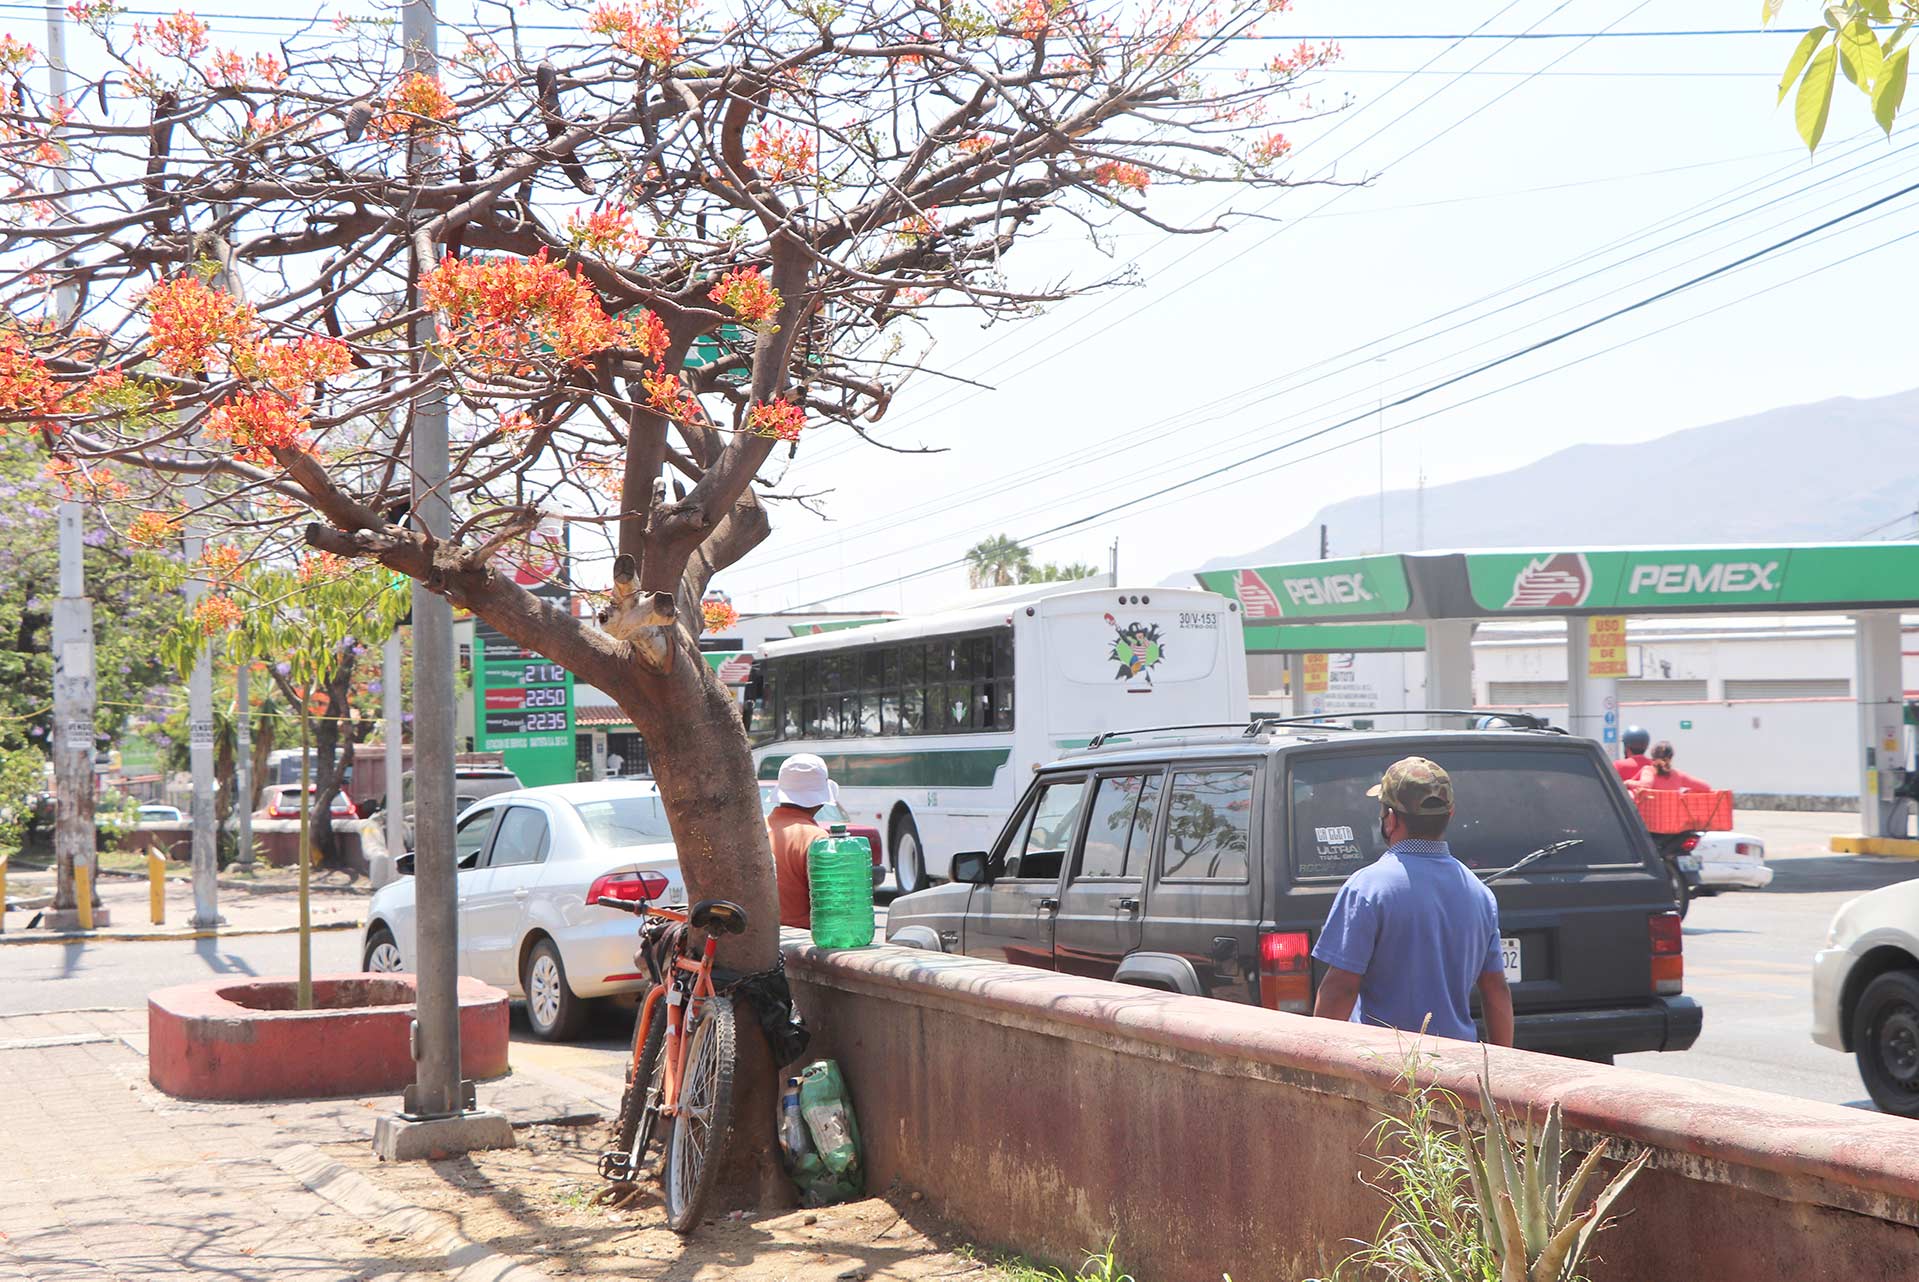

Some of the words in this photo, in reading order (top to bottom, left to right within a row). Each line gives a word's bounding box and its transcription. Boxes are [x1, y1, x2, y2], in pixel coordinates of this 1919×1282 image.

[1628, 561, 1779, 594] PEMEX
[1283, 572, 1373, 605] PEMEX
[1596, 619, 1619, 632] USO
[1600, 649, 1615, 658] DE
[1316, 844, 1360, 855] ULTRA
